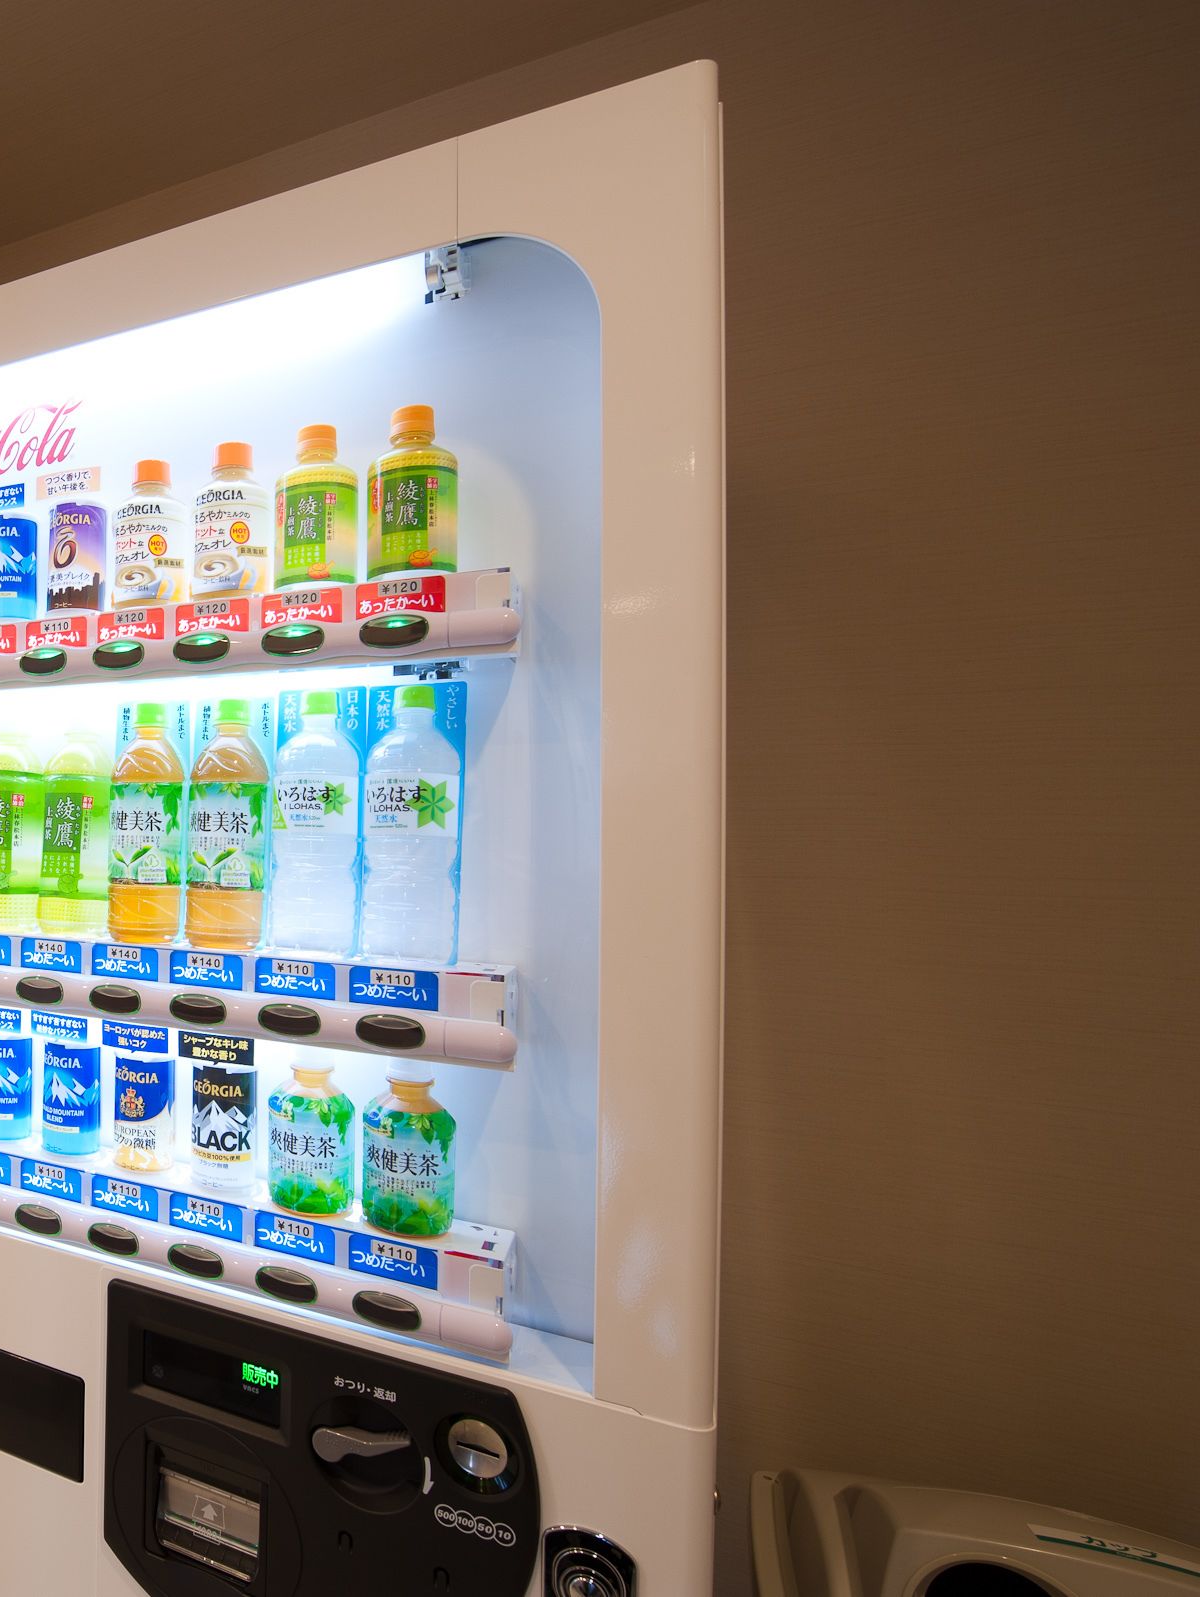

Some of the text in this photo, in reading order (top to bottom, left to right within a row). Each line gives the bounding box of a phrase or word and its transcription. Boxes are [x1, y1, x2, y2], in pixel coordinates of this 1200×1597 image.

[396, 479, 420, 526] 綾鷹
[297, 496, 319, 540] 綾鷹
[381, 581, 418, 594] ¥120
[285, 593, 318, 605] ¥120
[197, 603, 228, 615] ¥120
[116, 612, 145, 623] ¥120
[44, 622, 69, 632] ¥110
[284, 694, 297, 733] 天然水
[347, 690, 359, 729] 日本の
[376, 690, 391, 731] 天然水
[446, 684, 459, 729] やさしい
[123, 707, 131, 742] 植物生まれ
[177, 704, 185, 740] ボトルまで
[202, 705, 211, 741] 植物生まれ
[261, 703, 270, 738] ボトルまで
[374, 805, 410, 813] LOHAS
[53, 797, 77, 848] 綾鷹
[375, 814, 397, 823] 天然水
[38, 942, 63, 953] ¥140
[111, 949, 138, 960] ¥140
[191, 956, 221, 968] ¥140
[277, 963, 309, 975] ¥110
[375, 974, 411, 986] ¥110
[32, 1014, 86, 1029] 甘すぎず苦すぎない
[36, 1025, 80, 1039] 絶妙なバランス
[103, 1024, 166, 1040] ヨーロッパが認めた
[118, 1037, 147, 1049] 強いコク
[183, 1034, 249, 1051] シャープなキレ味
[192, 1047, 237, 1061] 豊かな香り
[194, 1078, 243, 1097] GEORGIA
[46, 1115, 63, 1123] BLEND
[56, 1108, 84, 1117] MOUNTAIN
[192, 1125, 252, 1152] BLACK
[271, 1127, 336, 1159] 爽健美茶
[368, 1144, 439, 1176] 爽健美茶
[38, 1166, 63, 1179] ¥110
[111, 1182, 138, 1197] ¥110
[190, 1200, 220, 1216] ¥110
[277, 1220, 310, 1237] ¥110
[377, 1244, 413, 1261] ¥110
[242, 1362, 279, 1389] 販売中
[334, 1375, 397, 1402] おつり・返却
[438, 1510, 455, 1521] 500
[457, 1517, 474, 1528] 100
[478, 1523, 492, 1534] 50
[498, 1530, 512, 1540] 10
